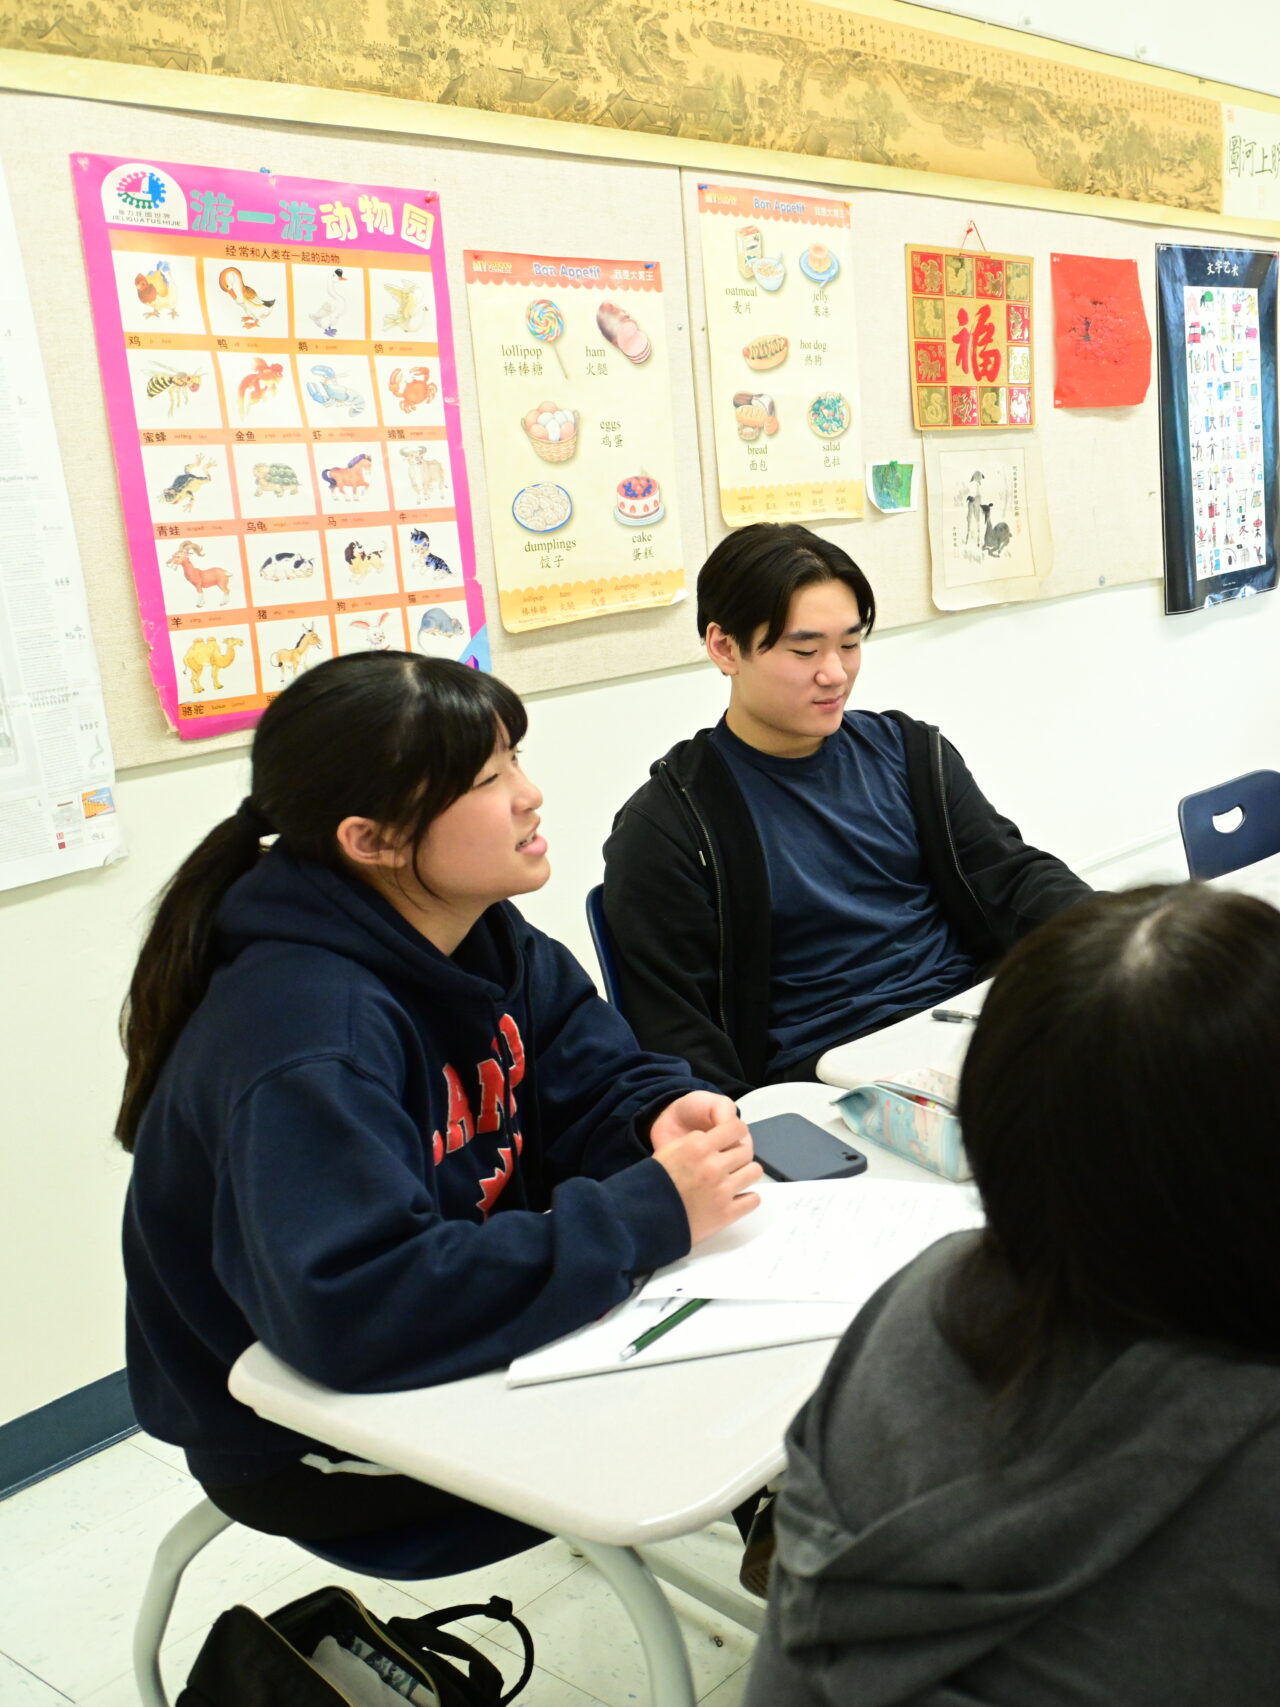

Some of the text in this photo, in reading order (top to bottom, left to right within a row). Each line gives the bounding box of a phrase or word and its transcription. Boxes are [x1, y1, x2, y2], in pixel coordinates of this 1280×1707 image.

[754, 198, 805, 213] Bon Appetit
[189, 189, 435, 249] 游一游动物园
[225, 244, 341, 264] 经常和人类在一起的动物
[533, 263, 601, 280] Bon Appetit
[1206, 260, 1239, 277] 文字艺术
[725, 287, 757, 297] oatmeal
[813, 290, 828, 302] jelly
[129, 335, 141, 347] 鸡
[217, 339, 229, 350] 鸭
[800, 340, 827, 351] hot dog
[952, 303, 1002, 383] 福
[501, 345, 543, 360] lollipop
[585, 346, 606, 357] ham
[503, 362, 543, 376] 棒棒糖
[585, 363, 608, 376] 火腿
[600, 421, 622, 432] eggs
[143, 430, 167, 443] 蜜蜂
[235, 430, 257, 442] 金鱼
[312, 430, 323, 441] 虾
[601, 434, 624, 448] 鸡蛋
[747, 445, 768, 455] bread
[822, 442, 840, 451] salad
[750, 459, 768, 471] 面包
[327, 516, 337, 527] 马
[400, 512, 408, 522] 牛
[156, 525, 181, 537] 青蛙
[246, 521, 267, 533] 乌龟
[631, 532, 652, 543] cake
[524, 538, 577, 553] dumplings
[540, 555, 564, 569] 饺子
[336, 601, 346, 612] 狗
[257, 609, 268, 620] 猪
[171, 616, 183, 628] 羊
